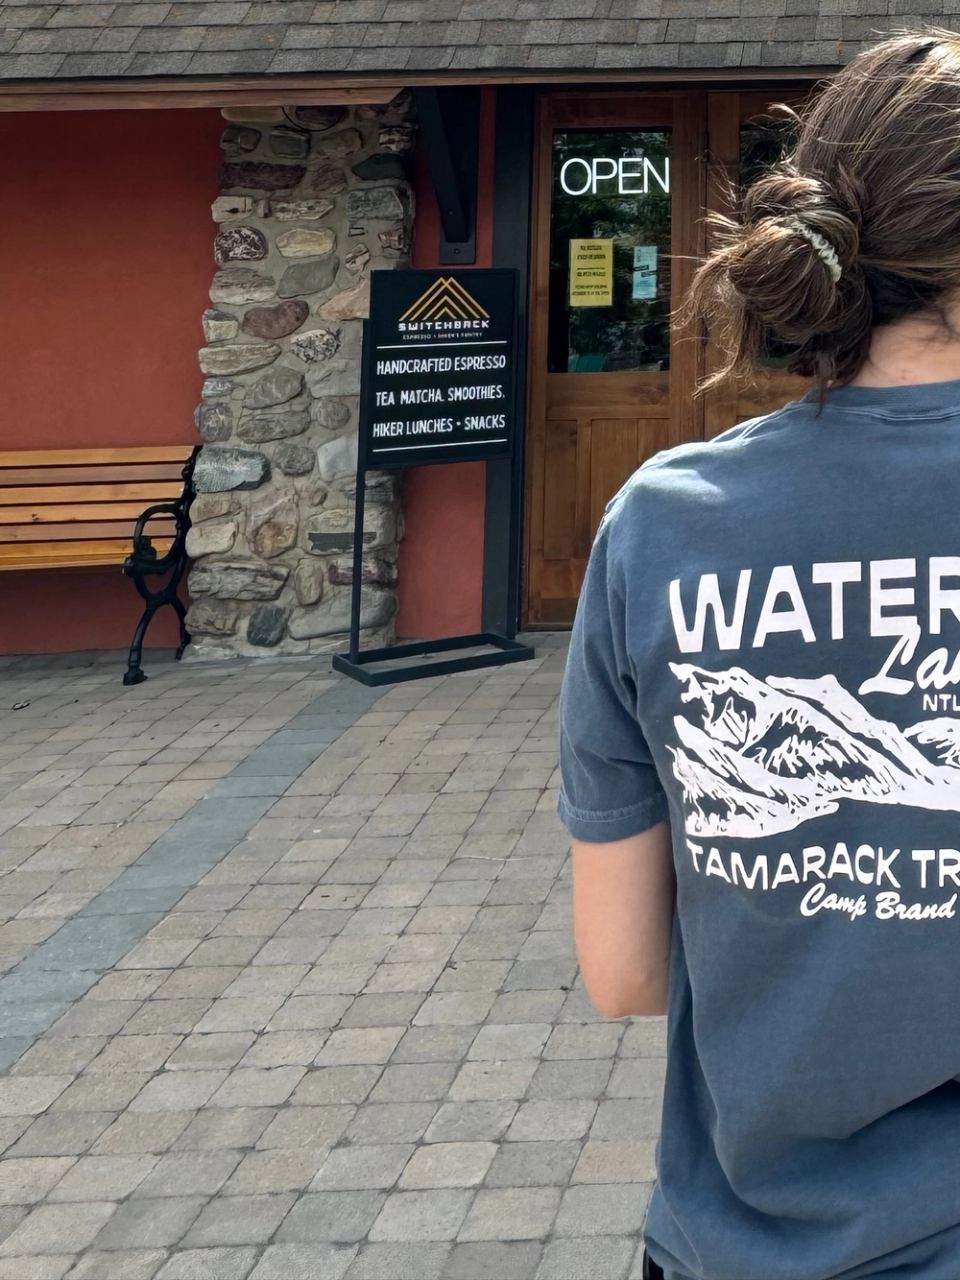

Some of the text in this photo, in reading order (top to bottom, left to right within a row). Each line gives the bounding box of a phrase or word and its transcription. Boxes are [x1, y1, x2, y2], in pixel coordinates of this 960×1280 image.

[560, 157, 669, 196] OPEN
[398, 320, 490, 331] SWITCHBACK
[376, 355, 506, 375] HANDCRAFTED ESPRESSO
[372, 414, 506, 437] HIKER LUNCHES SNACKS
[686, 838, 901, 891] TAMARACK
[800, 882, 867, 922] Camp
[875, 891, 958, 921] Brand
